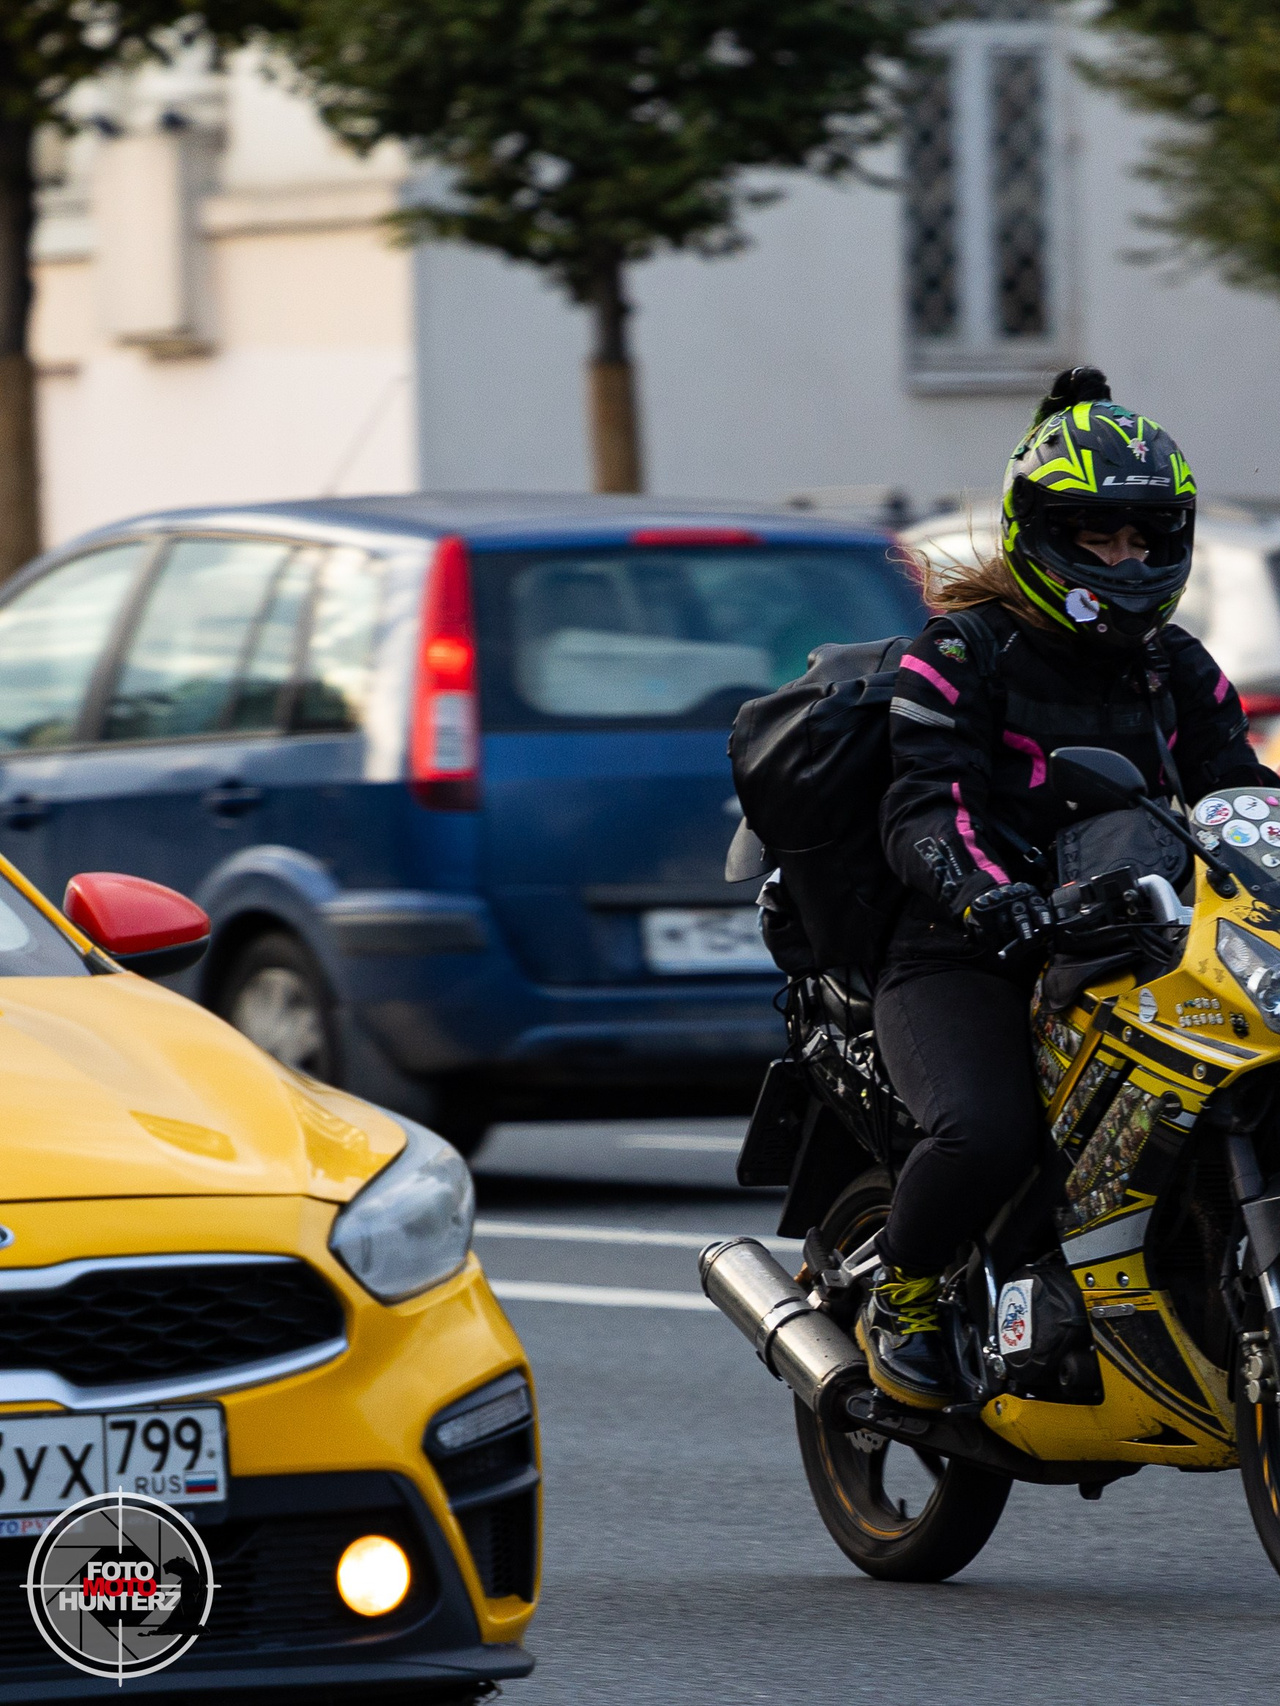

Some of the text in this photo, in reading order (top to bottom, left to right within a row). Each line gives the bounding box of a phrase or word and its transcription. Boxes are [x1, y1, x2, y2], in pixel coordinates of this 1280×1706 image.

[1102, 475, 1171, 487] LS2
[109, 1416, 202, 1475] 799
[134, 1475, 182, 1494] RUS
